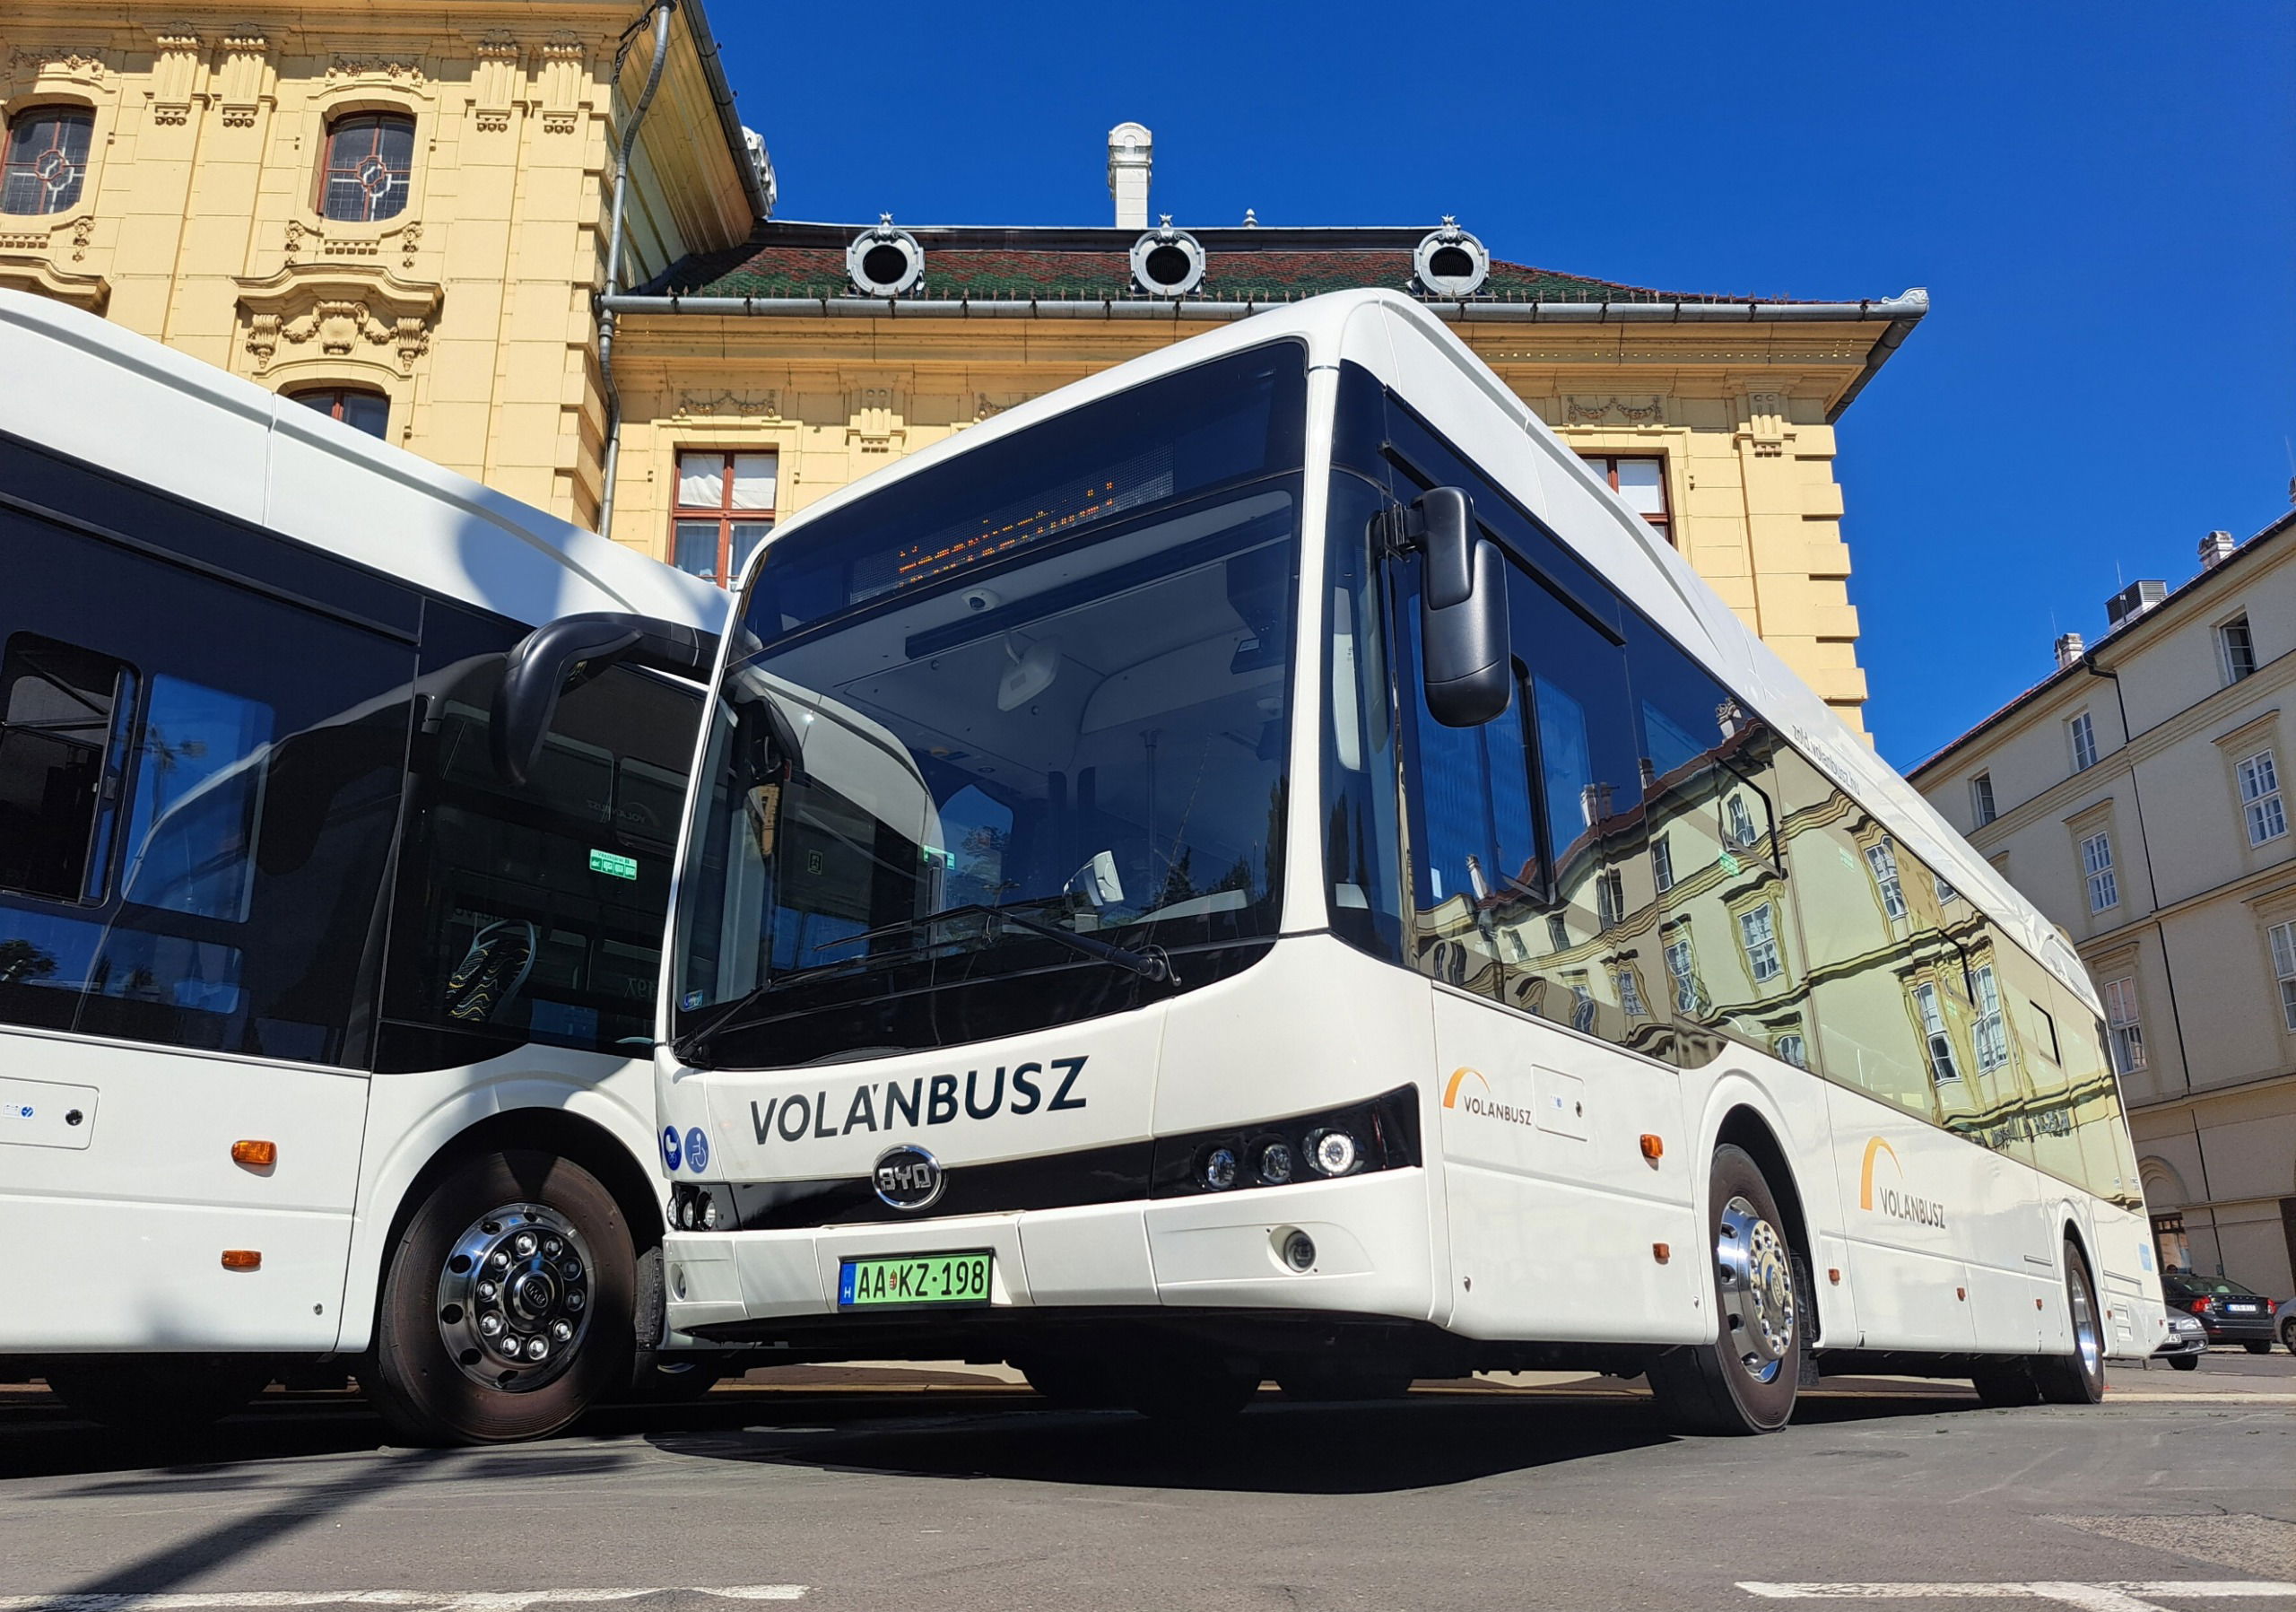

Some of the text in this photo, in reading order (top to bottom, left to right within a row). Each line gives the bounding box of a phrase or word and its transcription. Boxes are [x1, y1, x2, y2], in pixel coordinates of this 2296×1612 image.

[751, 1055, 1089, 1145] VOLÁNBUSZ
[1464, 1095, 1531, 1125] VOLÁNBUSZ
[878, 1163, 932, 1191] BYD
[1880, 1186, 1945, 1229] VOLÁNBUSZ
[843, 1286, 851, 1299] H
[857, 1265, 886, 1299] AA
